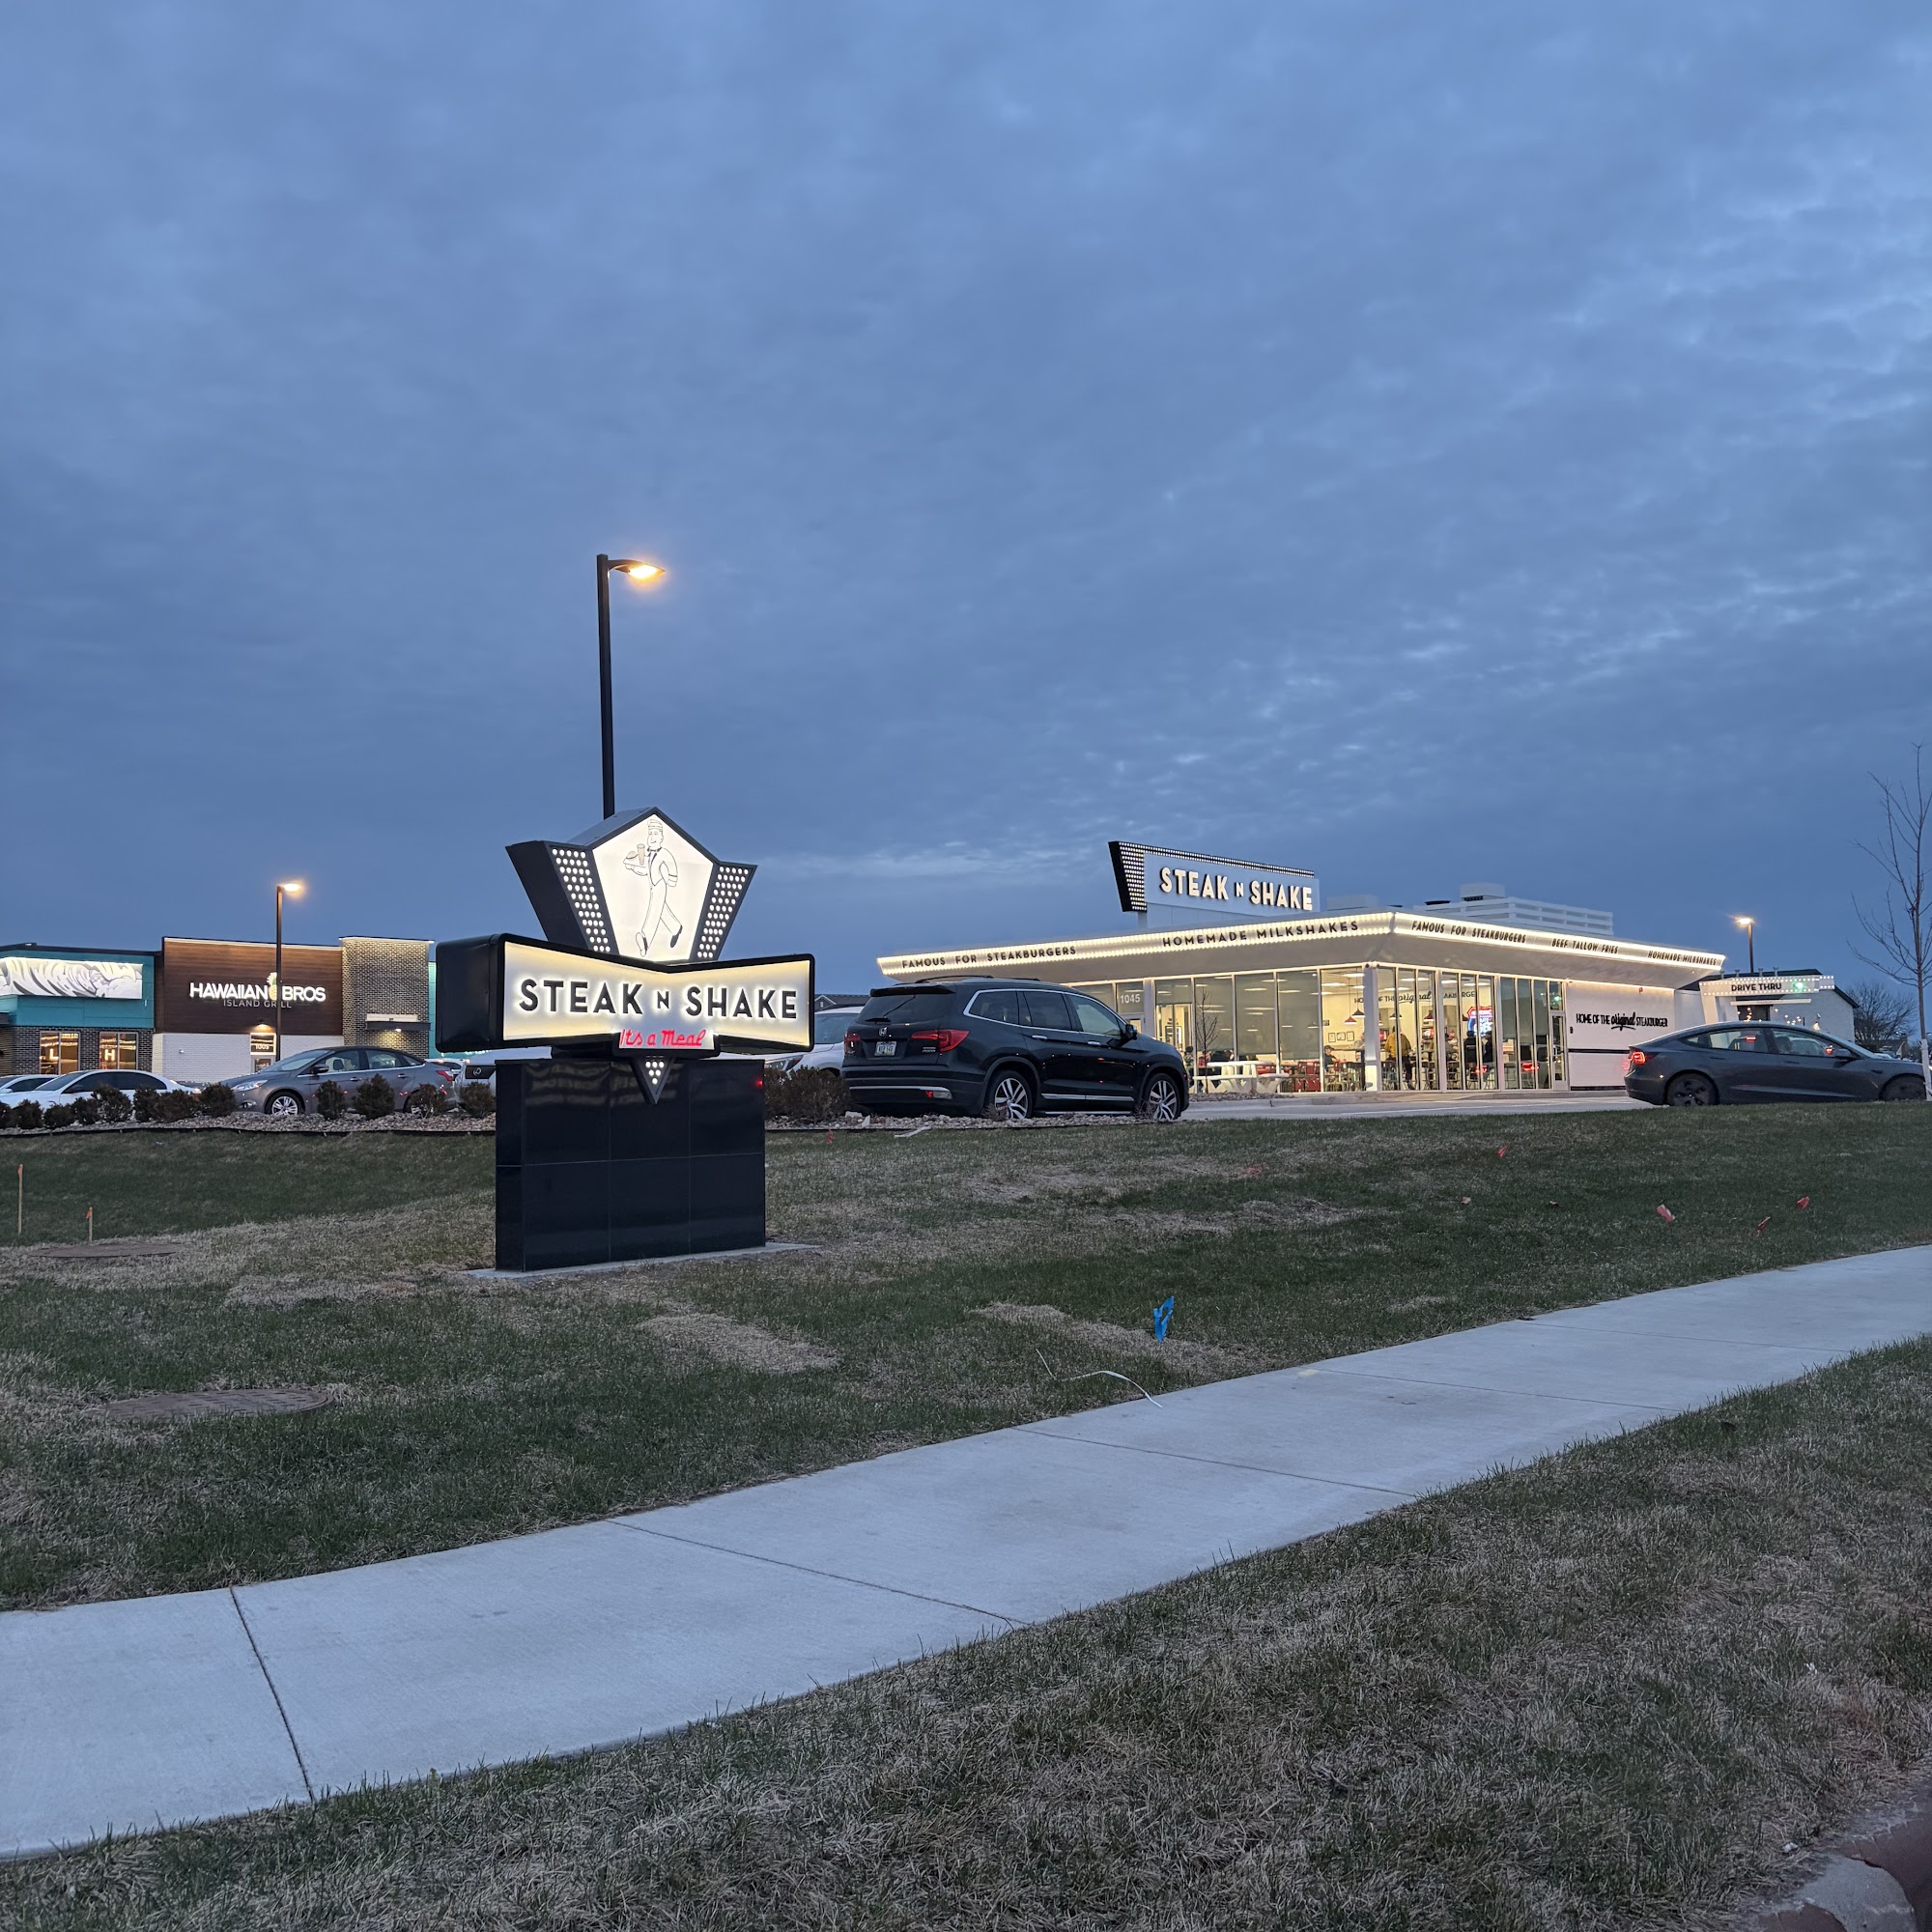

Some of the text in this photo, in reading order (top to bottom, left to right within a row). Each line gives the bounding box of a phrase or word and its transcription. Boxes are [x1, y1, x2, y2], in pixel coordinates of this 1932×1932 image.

[1160, 867, 1313, 911] STEAK N SHAKE
[1162, 921, 1359, 947] HOMEMADE MILKSHAKES
[1411, 921, 1526, 943] FAMOUS FOR STEAKBURGERS
[1551, 938, 1618, 953] BEEF TALLOW FRIES
[902, 946, 1076, 969] FAMOUS FOR STEAKBURGERS
[189, 982, 326, 1002] HAWAIIAN BROS
[1759, 982, 1782, 991] THRU
[223, 999, 260, 1008] ISLAND
[519, 979, 797, 1019] STEAK N SHAKE
[1121, 994, 1140, 1004] 1045
[1576, 1011, 1668, 1031] HOME OF THE original STEAKBURGER
[646, 1033, 656, 1045] a
[661, 1029, 706, 1046] Meal
